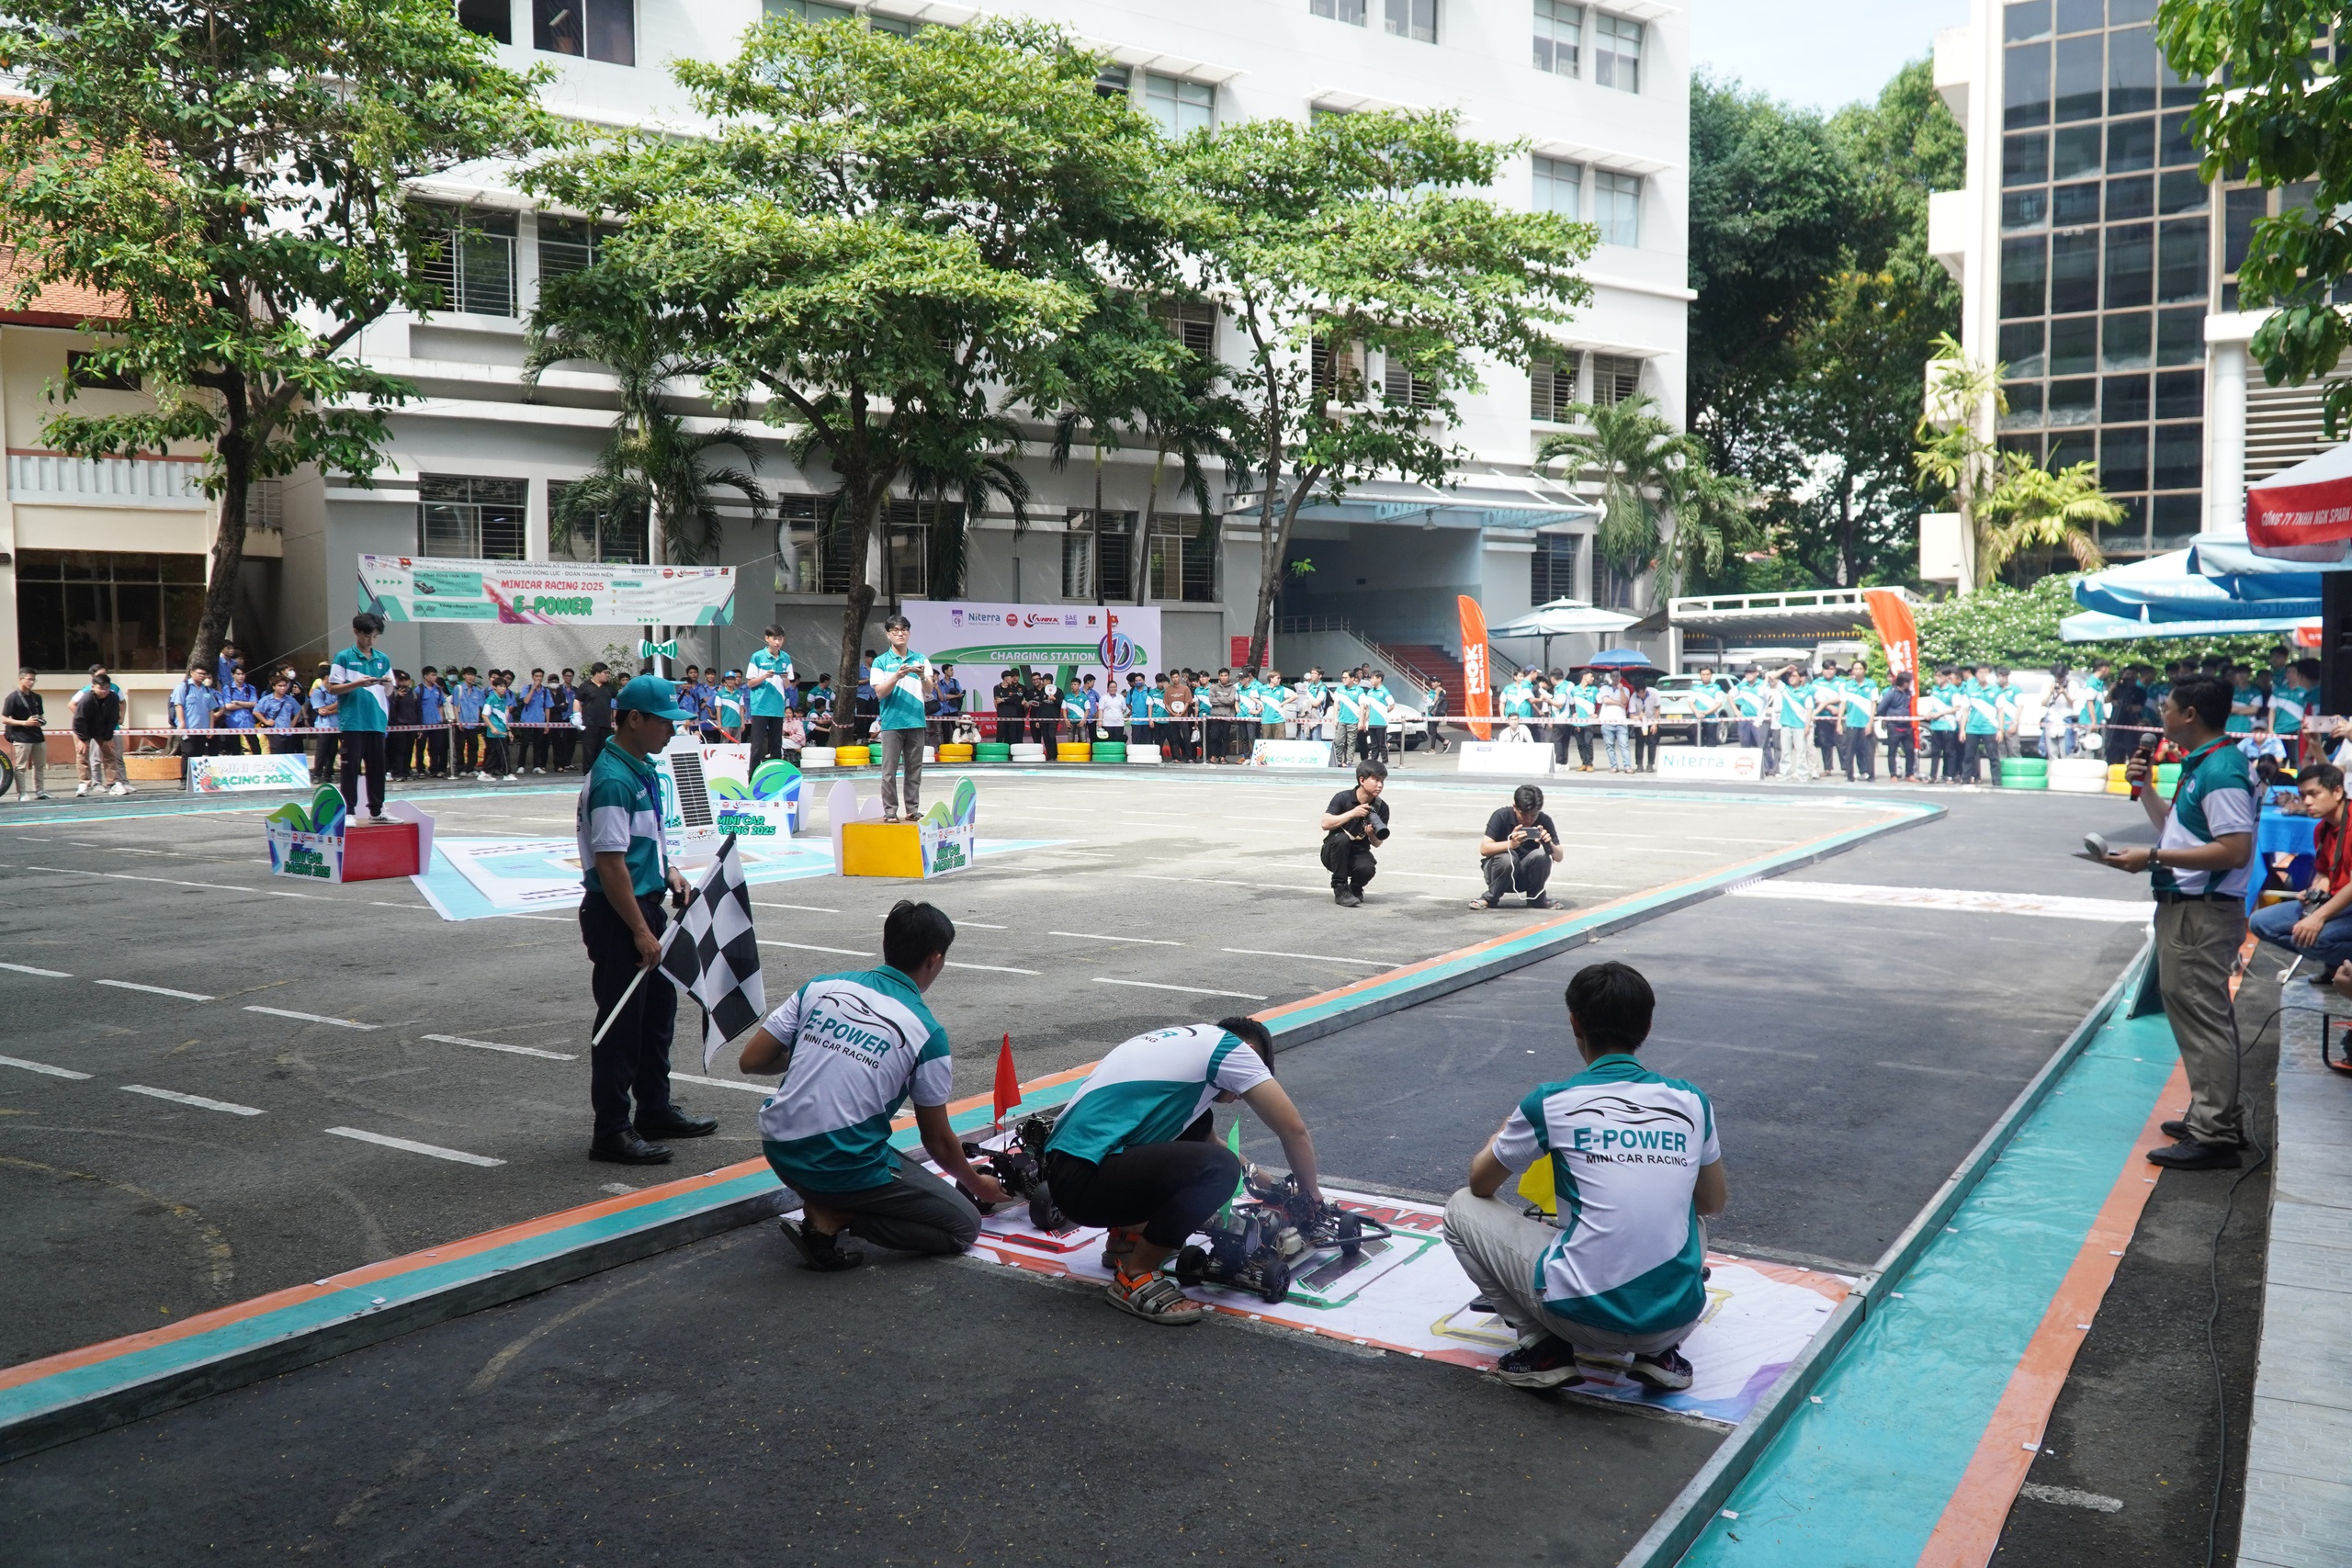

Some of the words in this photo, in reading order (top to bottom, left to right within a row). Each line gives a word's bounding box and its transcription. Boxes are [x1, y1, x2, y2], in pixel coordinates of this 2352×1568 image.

[2261, 510, 2283, 526] CÔNG
[2281, 512, 2295, 526] TY
[2291, 511, 2314, 525] TNHH
[2313, 509, 2330, 525] NGK
[2329, 506, 2352, 524] SPARK
[501, 580, 542, 590] MINICAR
[544, 581, 579, 591] RACING
[581, 581, 605, 591] 2025
[513, 595, 594, 616] E-POWER
[968, 613, 1001, 622] Niterra
[989, 651, 1048, 661] CHARGING
[1050, 651, 1096, 661] STATION
[1884, 640, 1905, 679] GK
[1465, 644, 1481, 694] NGK
[220, 763, 248, 773] MINI
[251, 762, 278, 772] CAR
[1663, 754, 1724, 768] Niterra
[210, 775, 261, 786] RACING
[263, 774, 292, 784] 2025
[717, 816, 741, 825] MINI
[742, 816, 765, 825] CAR
[718, 826, 749, 836] ACING
[749, 826, 776, 835] 2025
[949, 843, 960, 856] CAR
[289, 850, 306, 863] MINI
[307, 852, 323, 864] CAR
[284, 861, 312, 875] RACING
[312, 865, 331, 878] 2025
[803, 1009, 891, 1058] E-POWER
[803, 1033, 822, 1045] MINI
[822, 1040, 841, 1053] CAR
[842, 1047, 879, 1069] RACING
[1573, 1127, 1687, 1153] E-POWER
[1586, 1154, 1613, 1165] MINI
[1617, 1154, 1644, 1164] CAR
[1647, 1155, 1688, 1168] RACING
[1335, 1199, 1444, 1233] TAR
